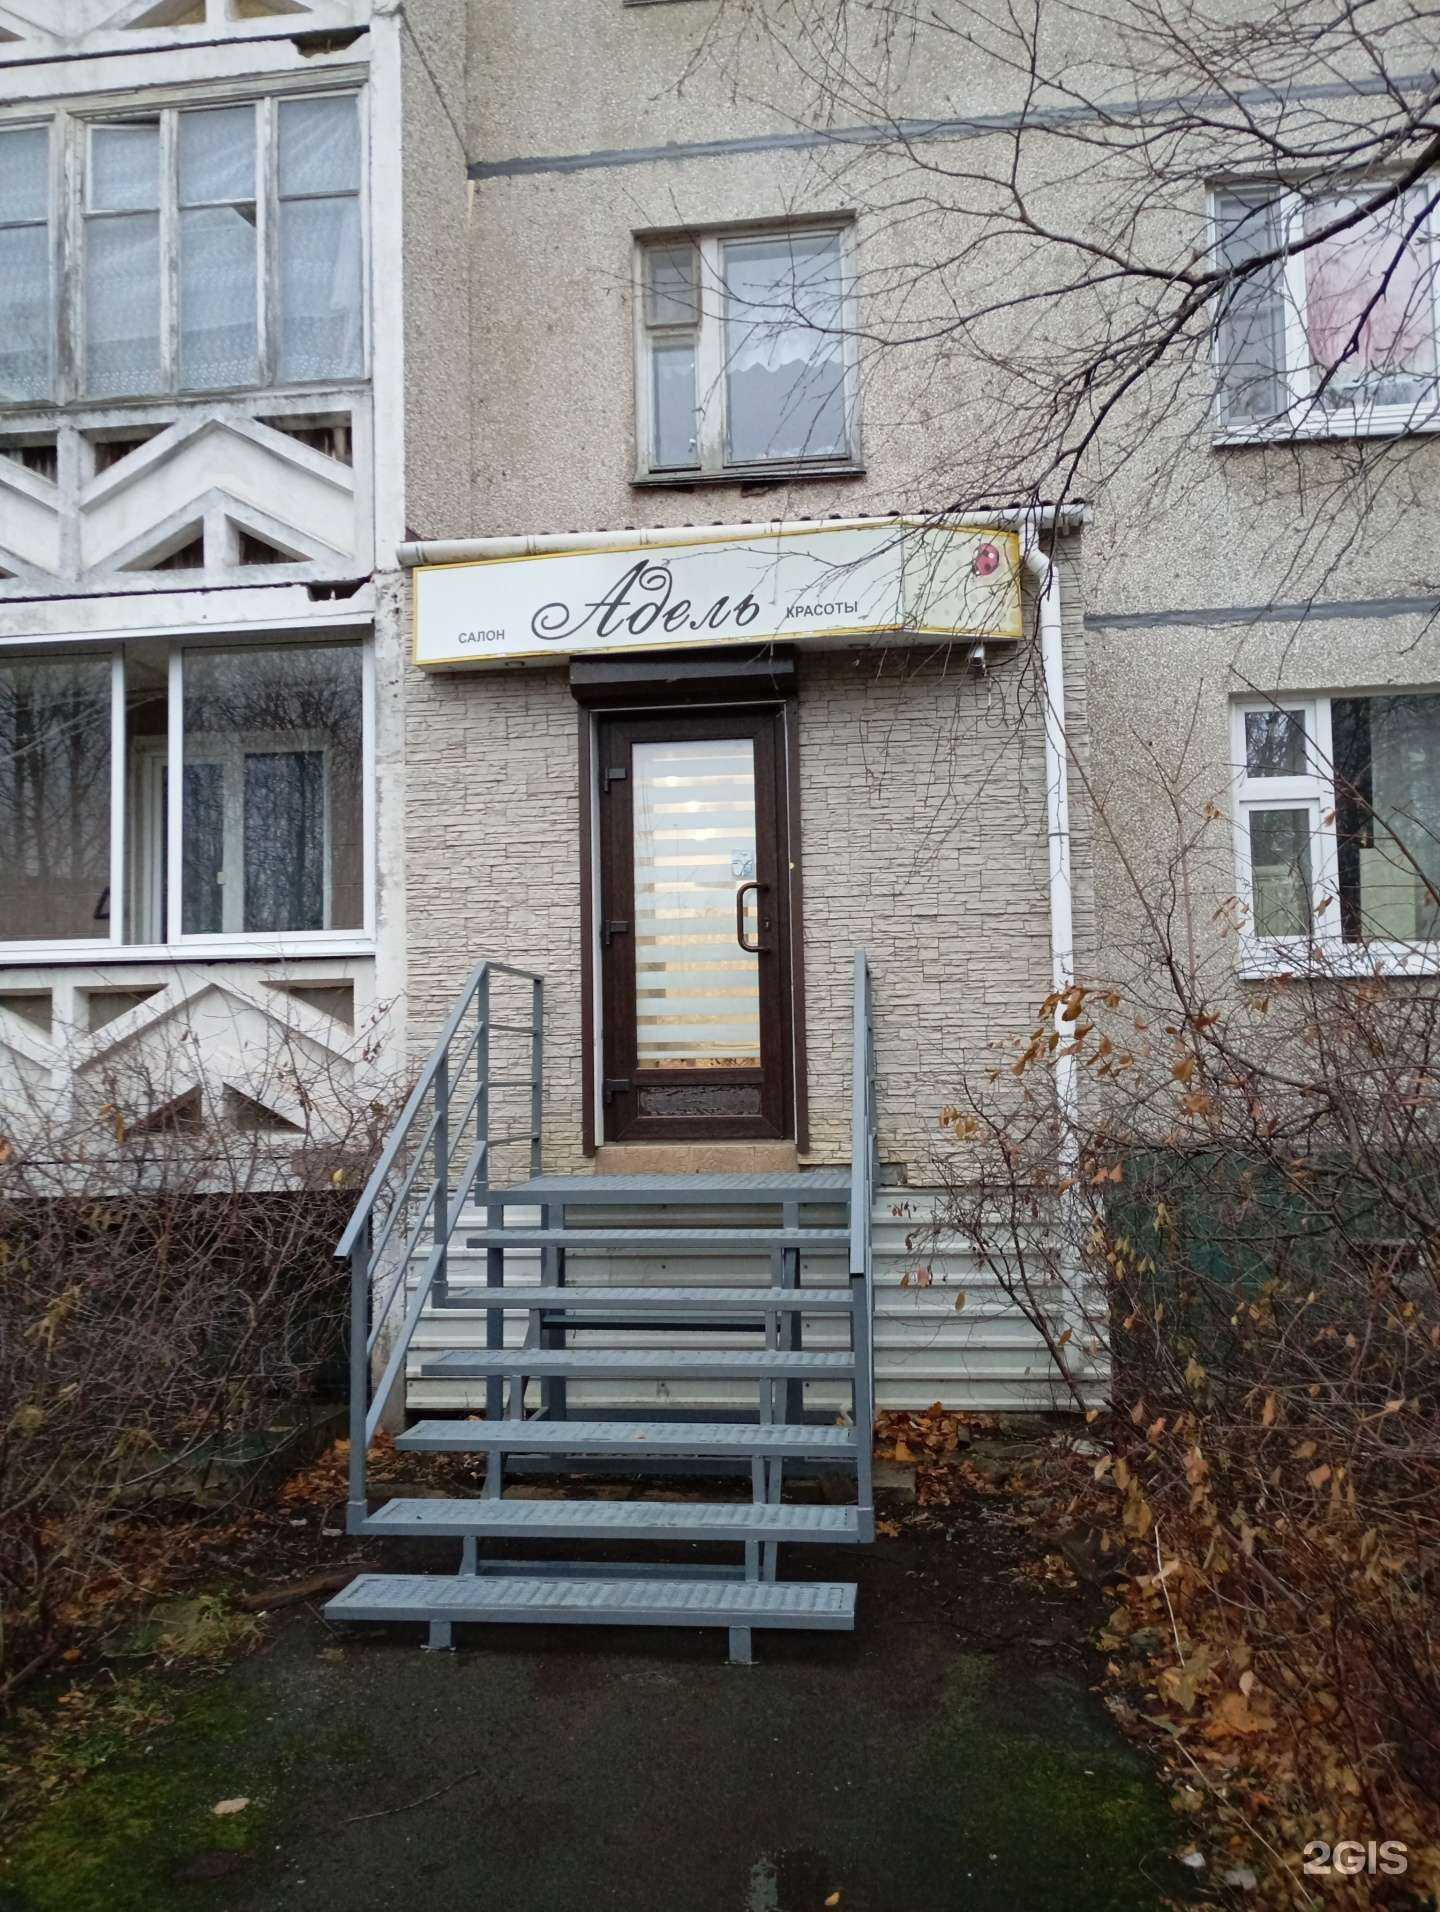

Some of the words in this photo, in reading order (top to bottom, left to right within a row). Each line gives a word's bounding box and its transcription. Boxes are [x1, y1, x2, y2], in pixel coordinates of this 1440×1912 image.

[458, 629, 505, 643] САЛОН
[531, 559, 760, 640] Адель
[786, 601, 858, 618] КРАСОТЫ
